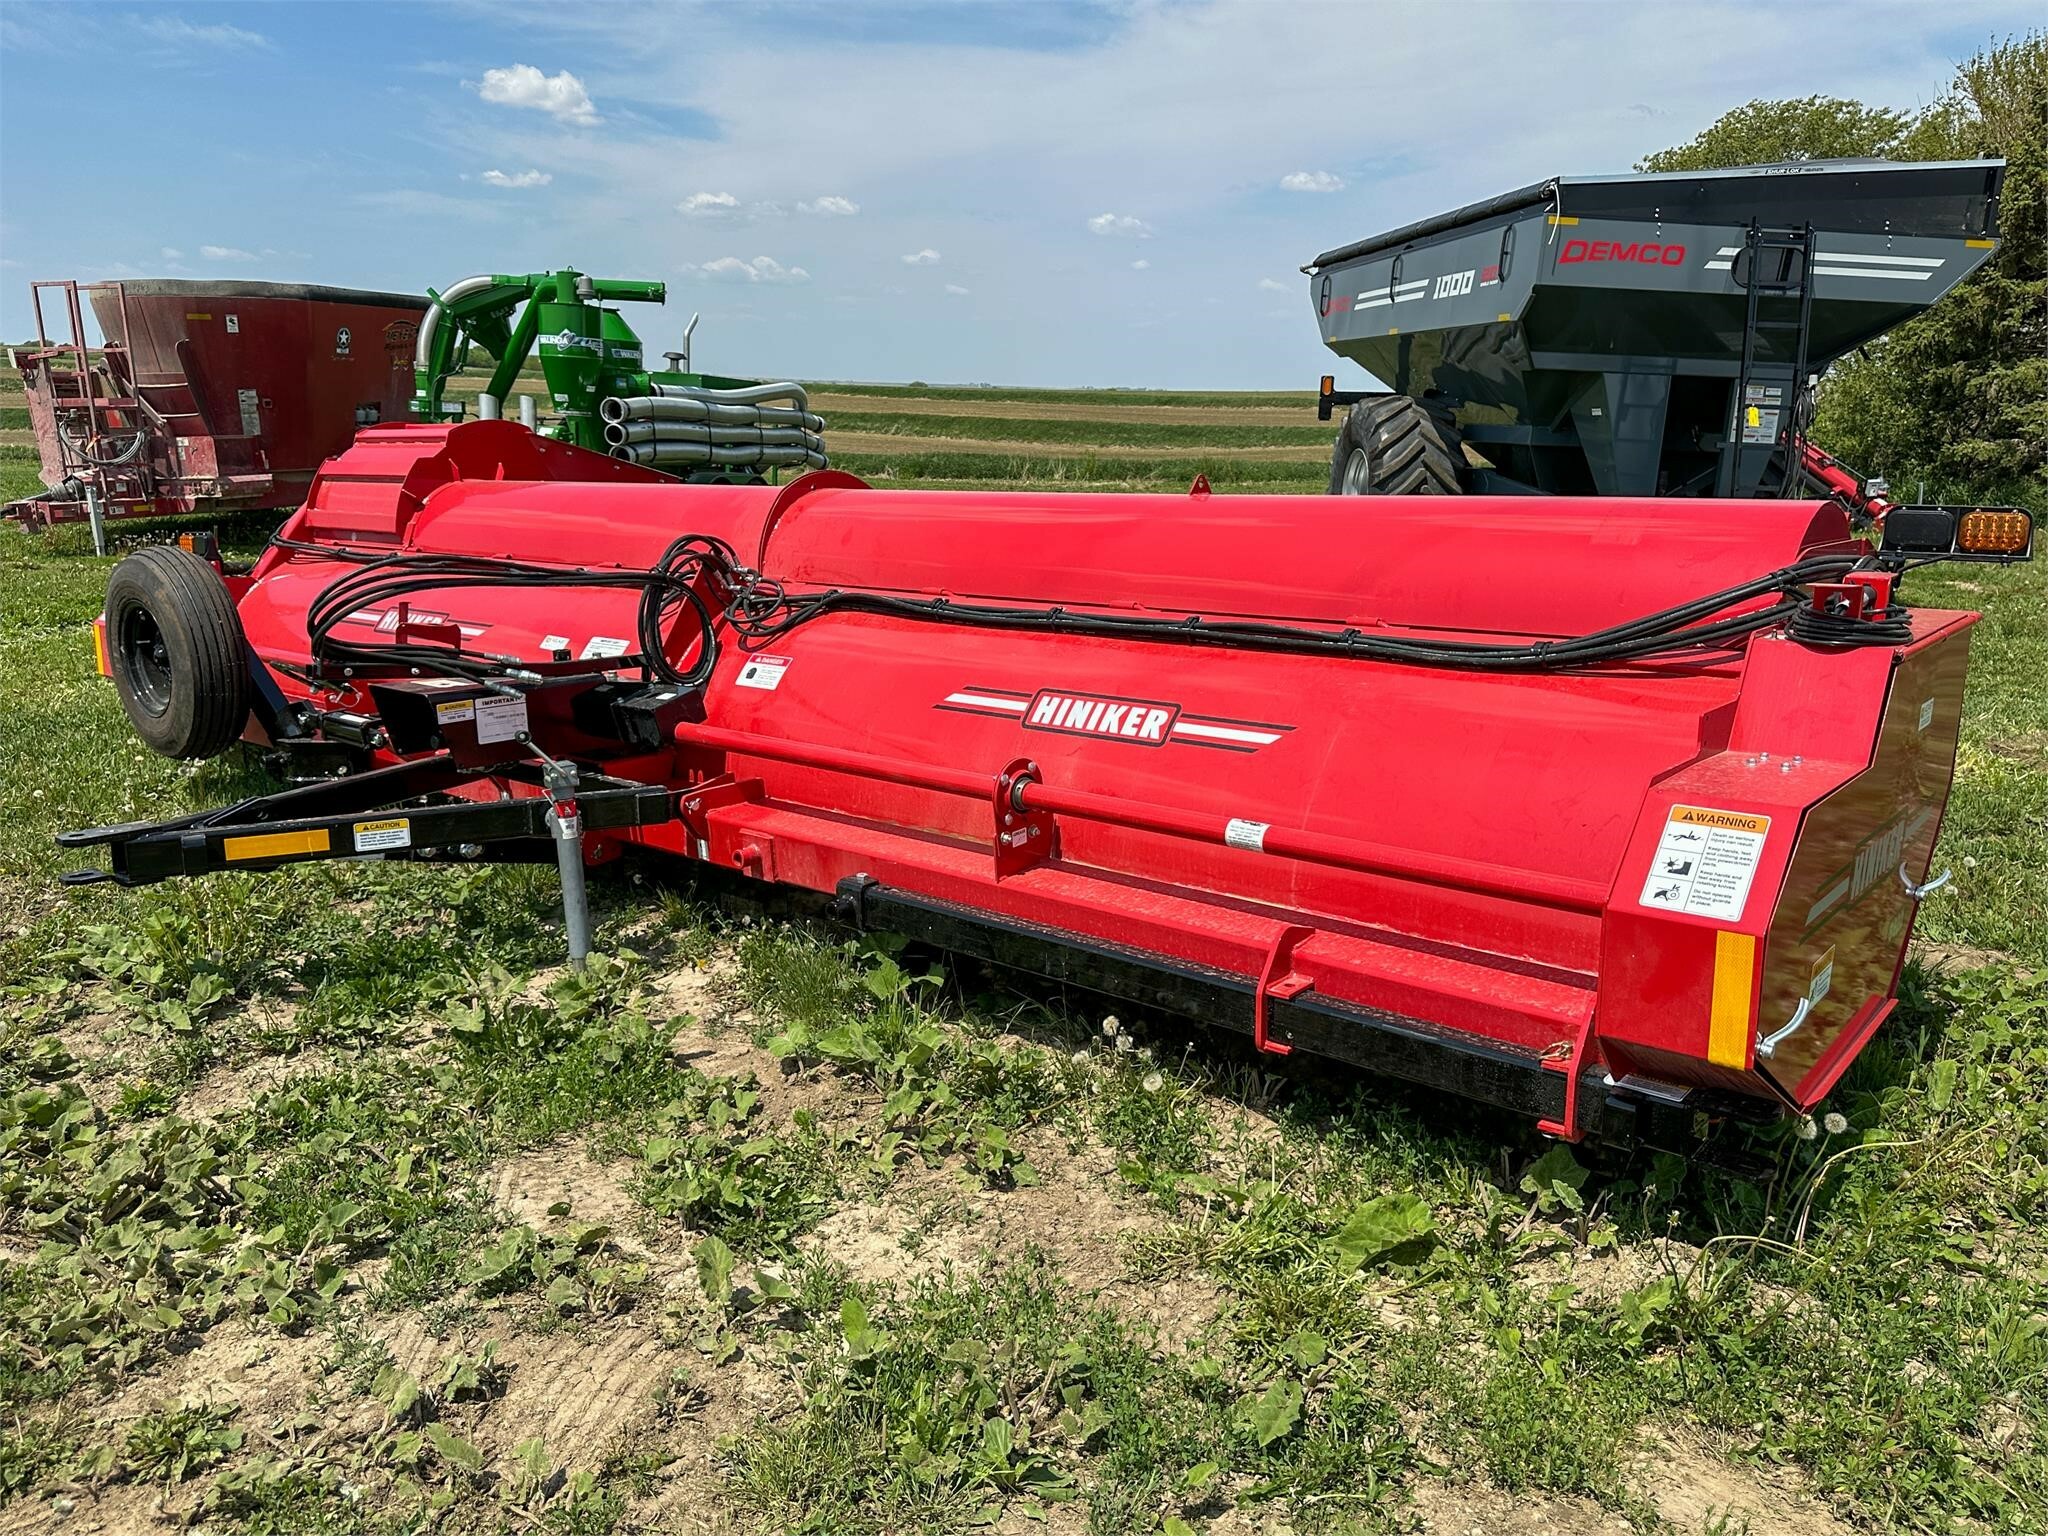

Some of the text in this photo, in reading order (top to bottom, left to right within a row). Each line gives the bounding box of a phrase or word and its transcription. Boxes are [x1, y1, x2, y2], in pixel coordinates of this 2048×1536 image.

[1559, 240, 1685, 266] DEMCO
[1433, 269, 1475, 300] 1000
[1031, 696, 1169, 740] HINIKER
[370, 822, 401, 830] CAUTION
[1696, 812, 1757, 830] WARNING
